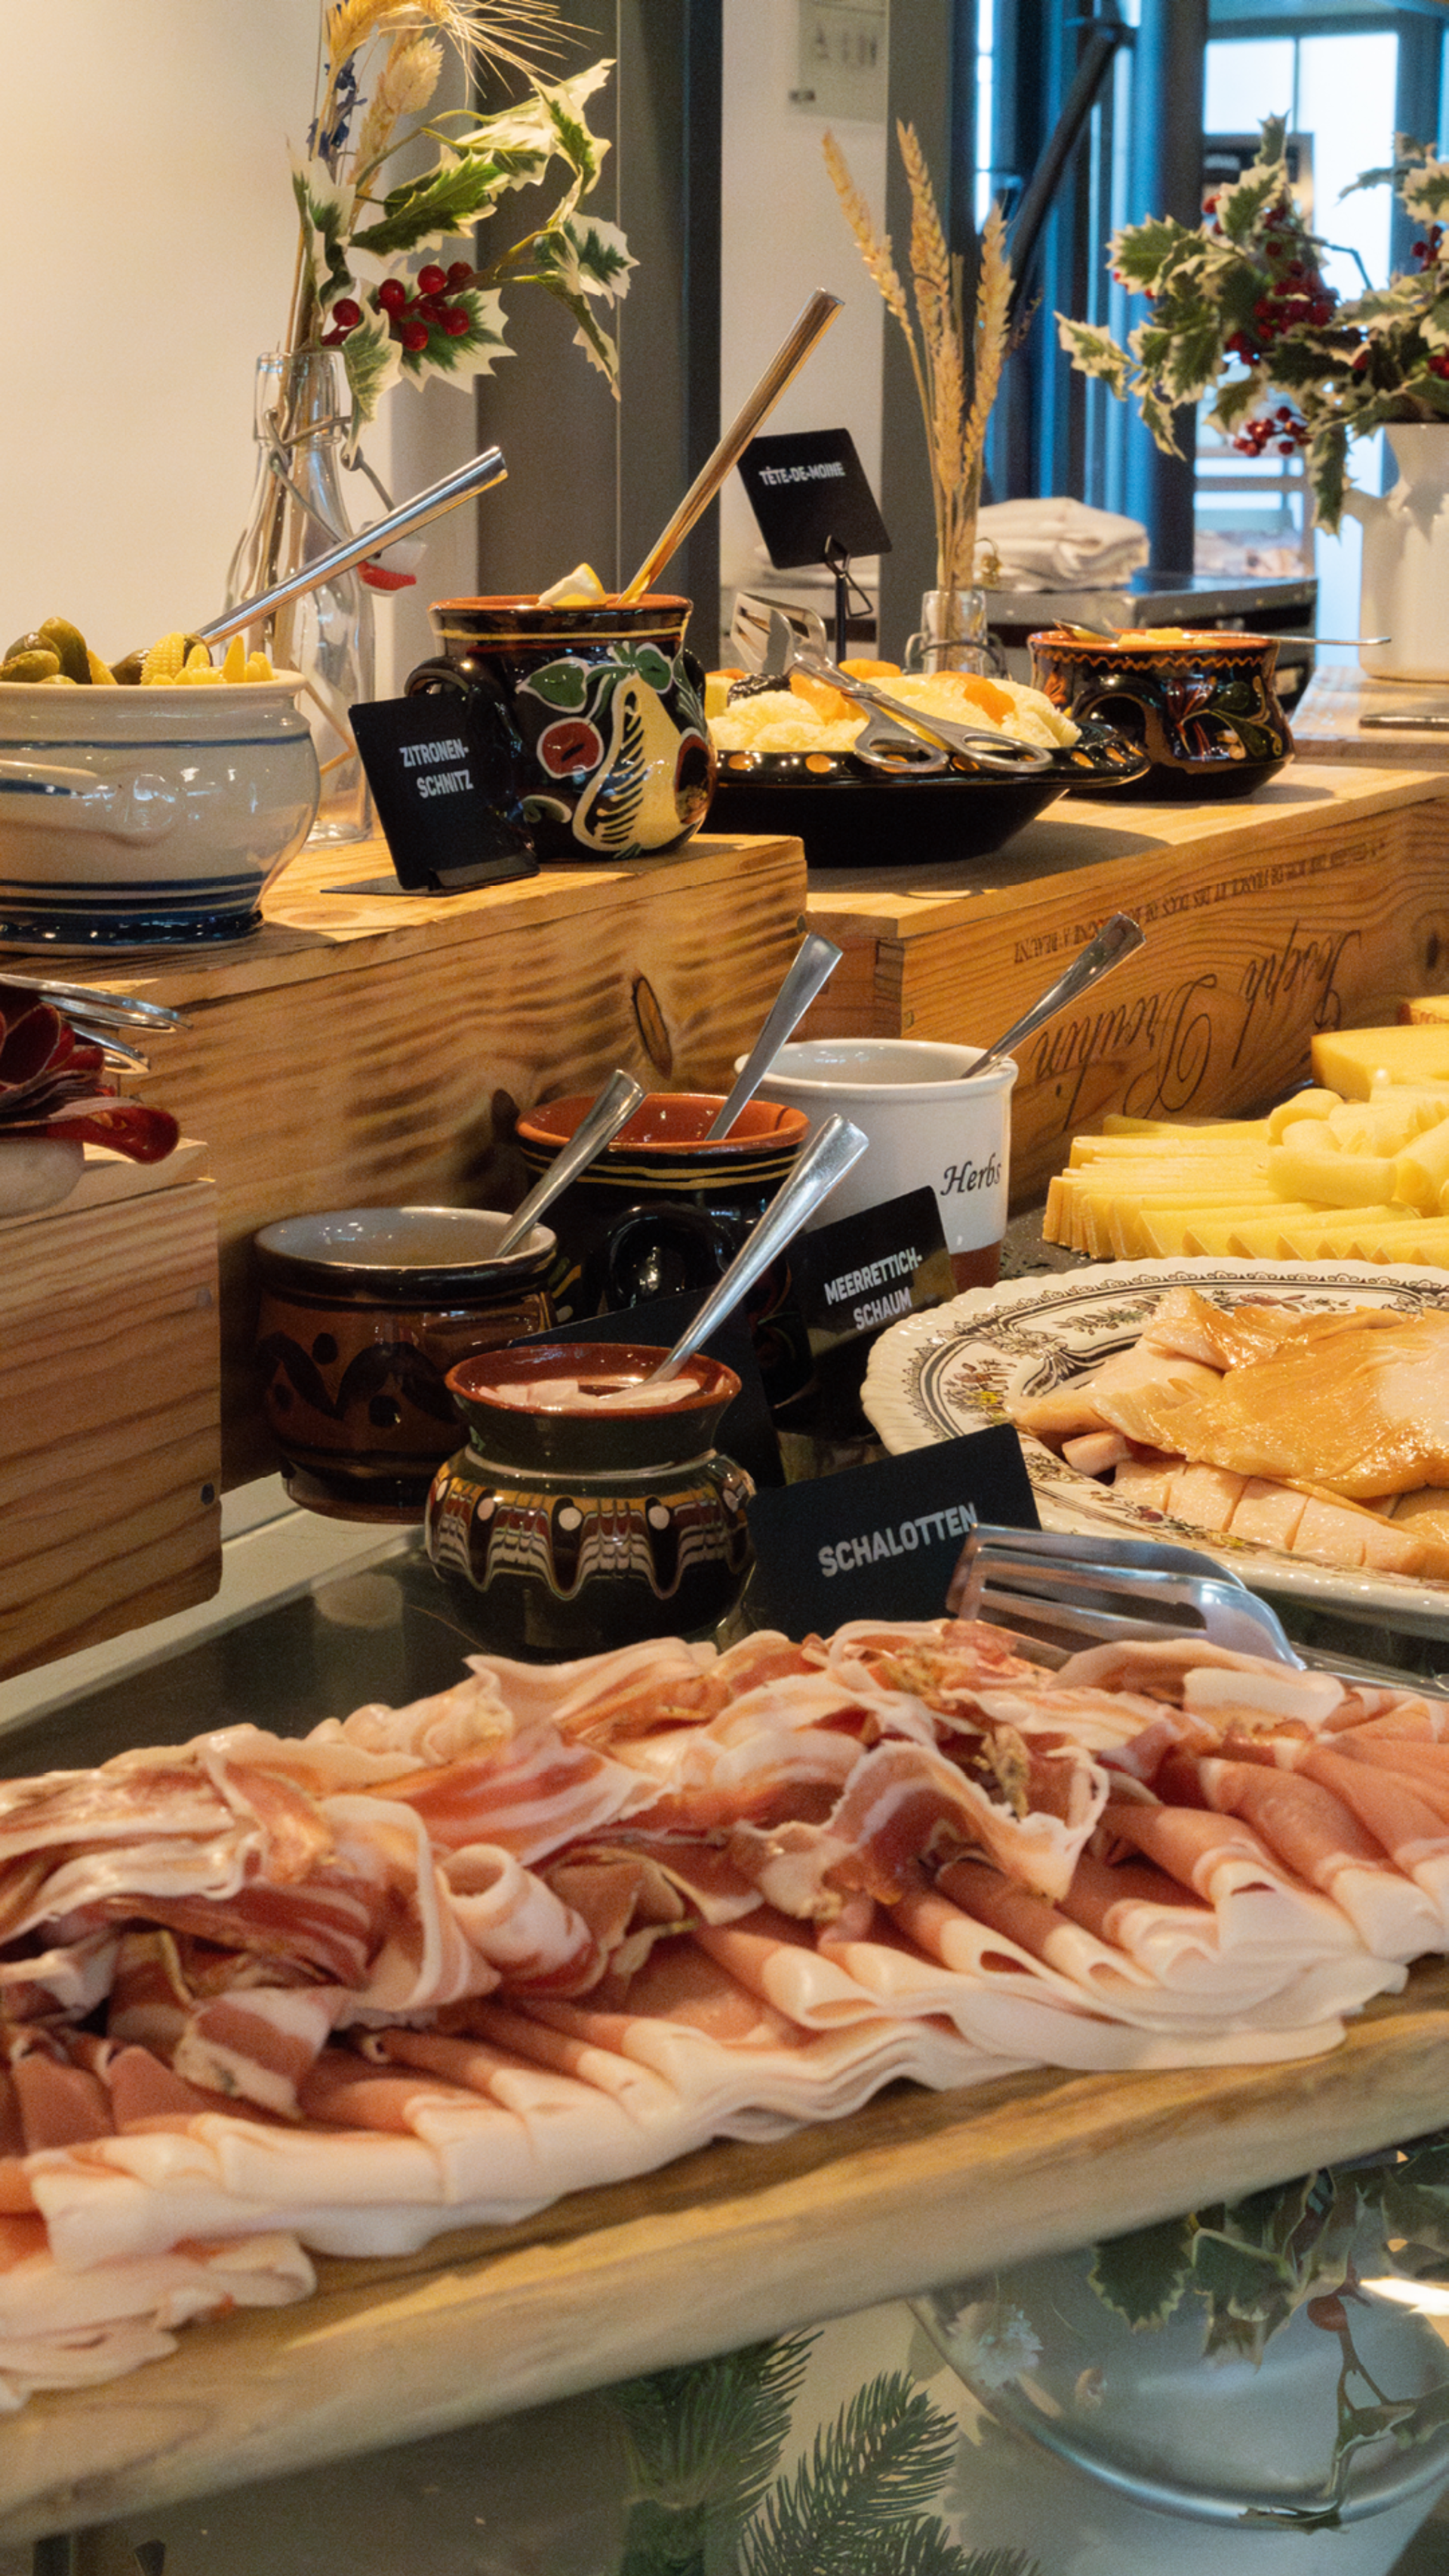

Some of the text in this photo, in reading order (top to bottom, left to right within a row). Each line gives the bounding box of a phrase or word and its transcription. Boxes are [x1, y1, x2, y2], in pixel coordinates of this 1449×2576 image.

[398, 738, 469, 768] ZITRONEN-
[417, 769, 474, 799] SCHNITZ
[1027, 973, 1217, 1132] Drouhin
[940, 1152, 1001, 1196] Herbs
[823, 1247, 923, 1305] MEERRETTICH-
[853, 1286, 913, 1331] SCHAUM
[818, 1502, 979, 1577] SCHALOTTEN
